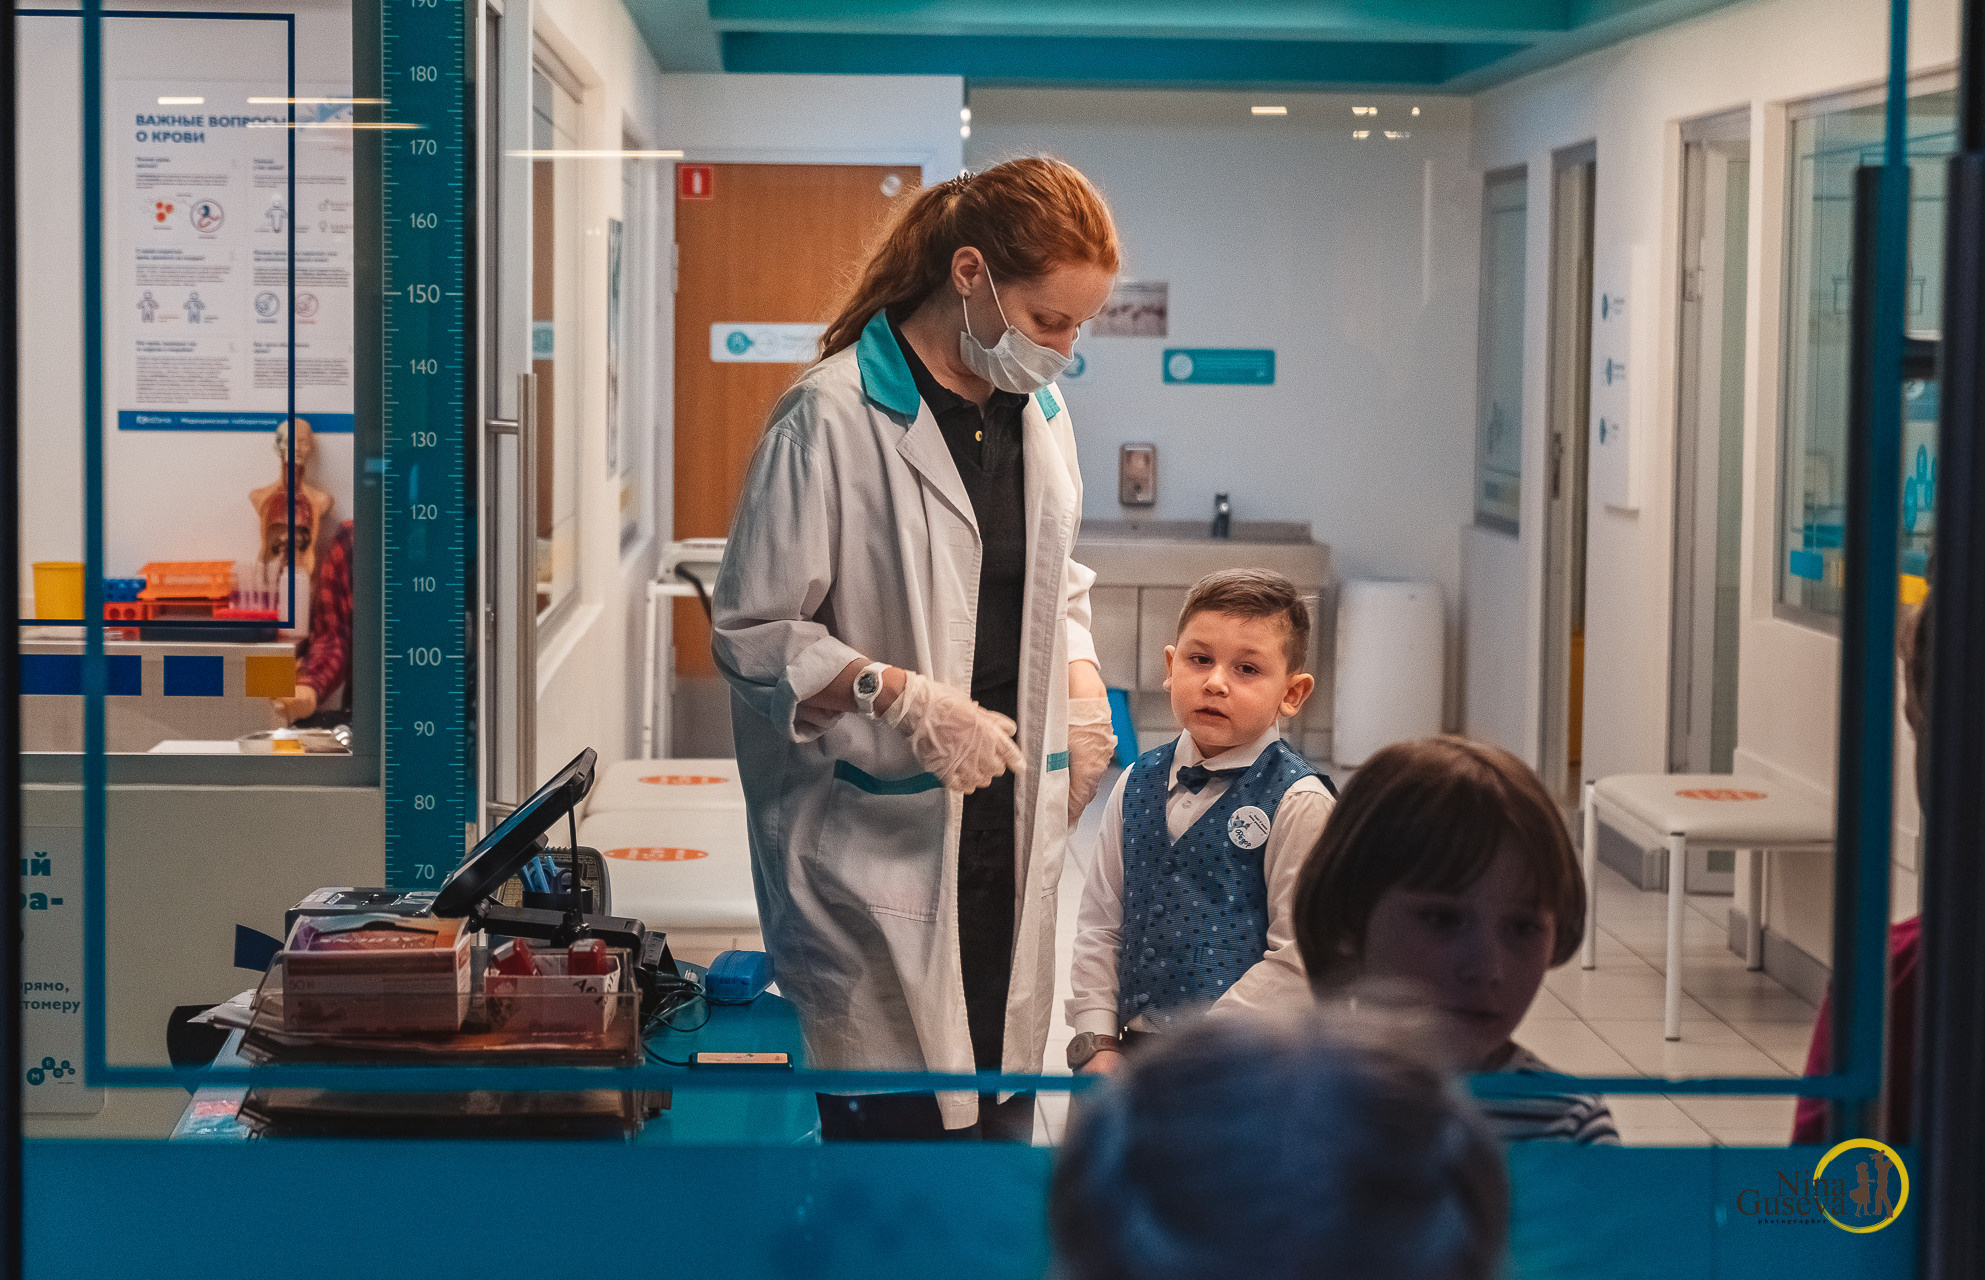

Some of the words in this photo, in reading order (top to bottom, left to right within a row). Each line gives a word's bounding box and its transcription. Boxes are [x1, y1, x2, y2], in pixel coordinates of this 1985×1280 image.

[409, 66, 437, 82] 180
[135, 114, 203, 127] ВАЖНЫЕ
[136, 131, 147, 143] О
[152, 131, 205, 143] КРОВИ
[409, 140, 437, 155] 170
[409, 213, 437, 228] 160
[407, 284, 440, 303] 150
[409, 359, 438, 374] 140
[410, 432, 437, 447] 130
[410, 504, 438, 520] 120
[412, 576, 436, 592] 110
[407, 647, 441, 666] 100
[414, 721, 435, 736] 90
[414, 794, 435, 810] 80
[414, 864, 435, 880] 70
[20, 981, 70, 994] рямо,
[21, 1000, 81, 1014] томеру
